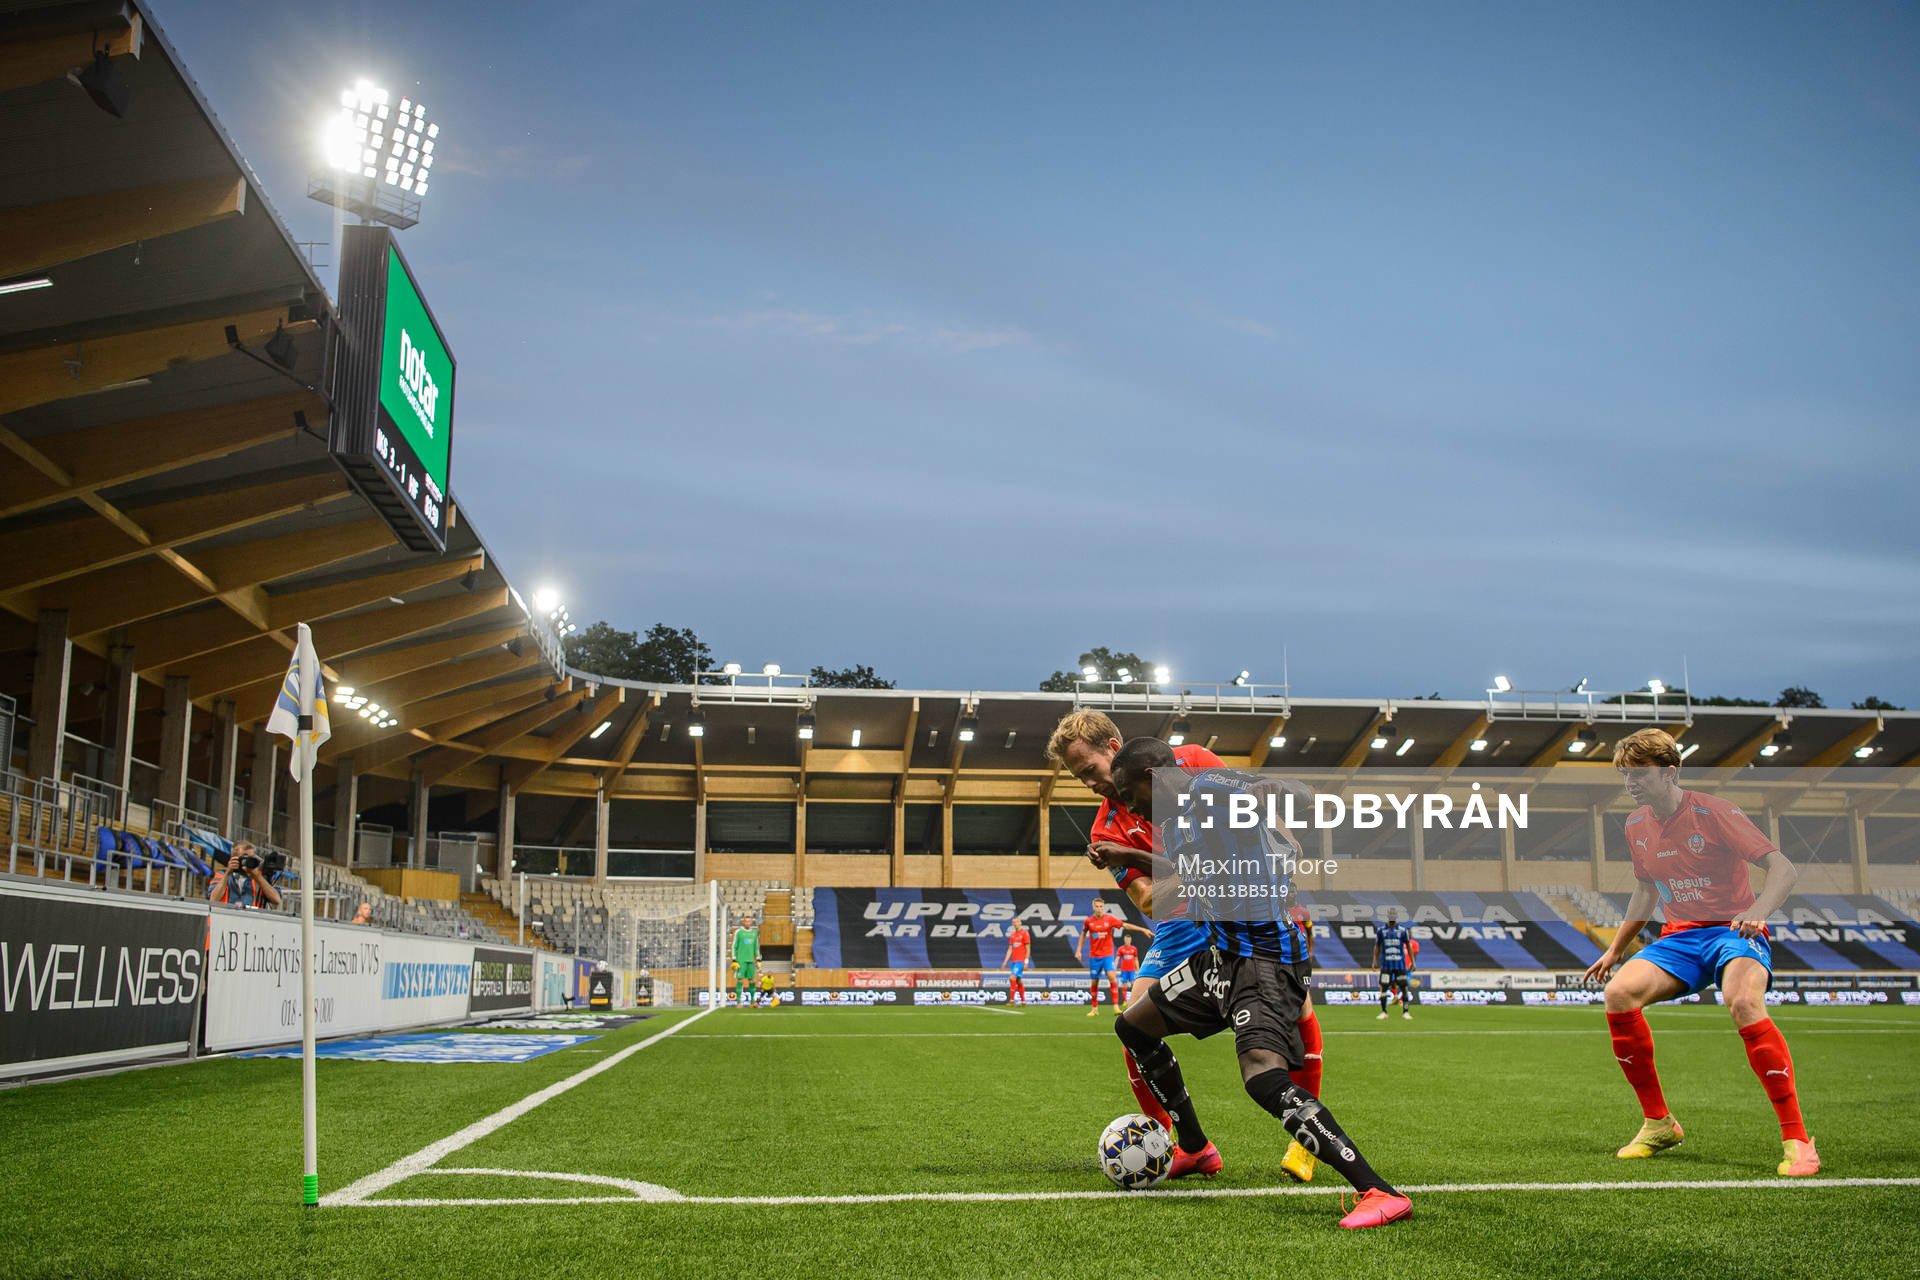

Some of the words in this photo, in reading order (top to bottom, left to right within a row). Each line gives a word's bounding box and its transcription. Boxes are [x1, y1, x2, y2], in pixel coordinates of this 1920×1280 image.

[400, 328, 439, 423] notar
[1668, 876, 1712, 891] Resurs
[1673, 889, 1704, 903] Bank
[863, 902, 1128, 921] UPPSALA
[1305, 903, 1520, 924] PPSALA
[865, 922, 922, 938] ÄR
[929, 922, 1125, 938] BLÅVAT
[1340, 925, 1527, 940] BLSVART
[214, 931, 239, 972] AB
[243, 932, 303, 987] Lindqvis
[320, 940, 358, 976] Larsson
[360, 943, 379, 975] VVS
[1, 941, 201, 1012] WELLNESS
[281, 999, 297, 1026] 018
[319, 997, 334, 1023] 000
